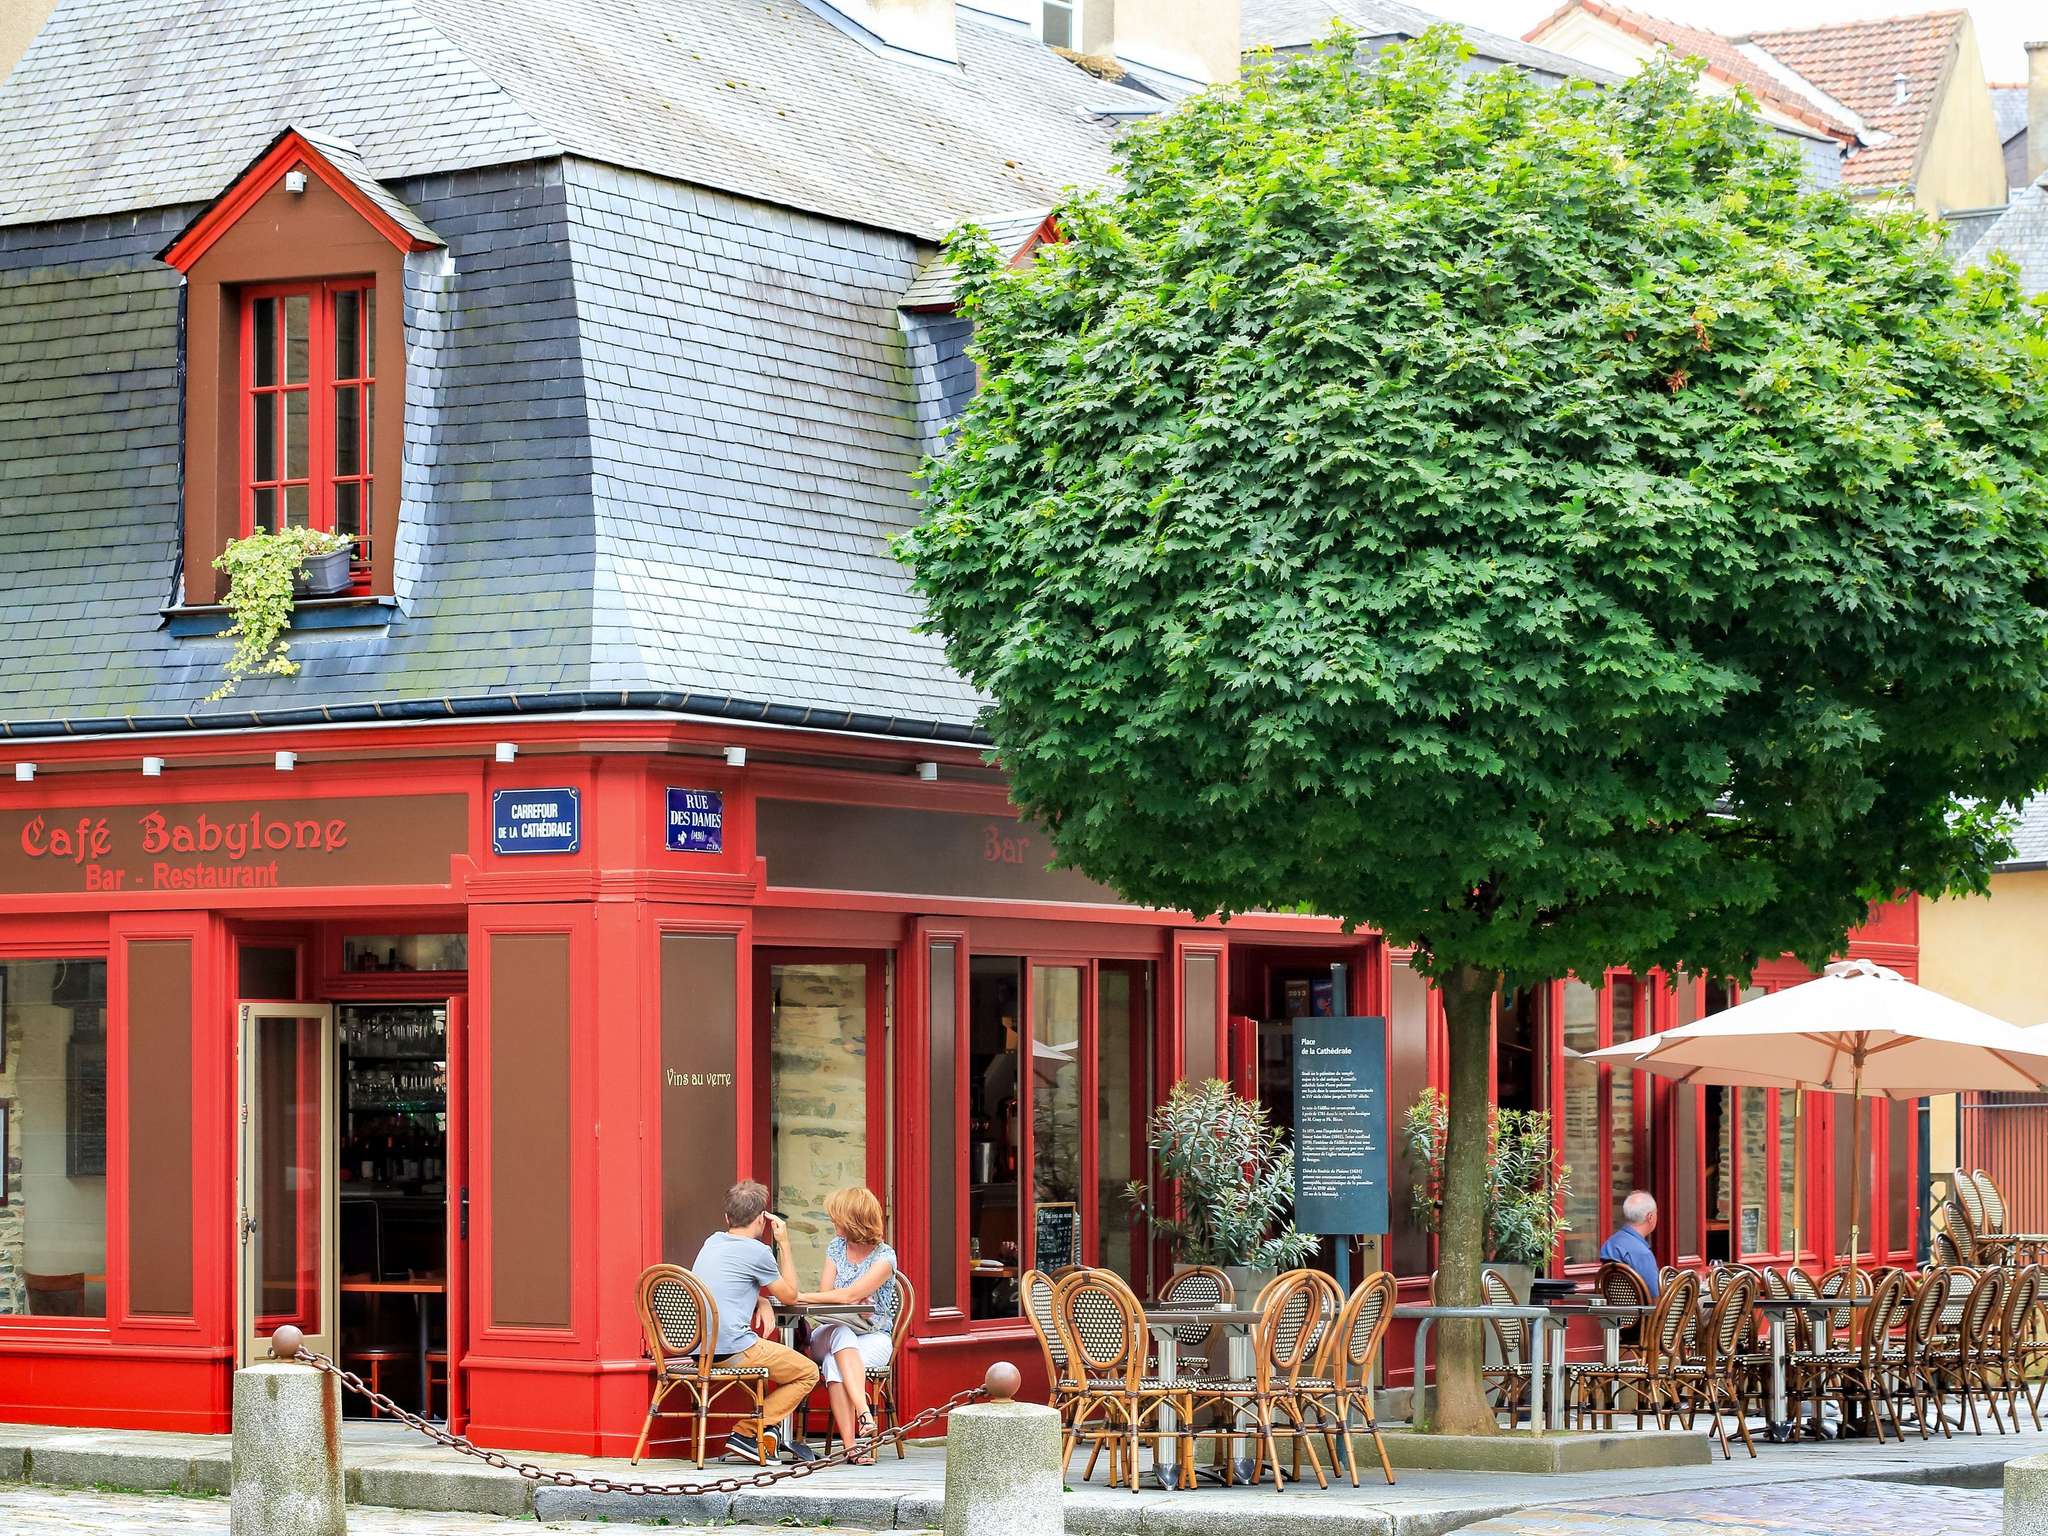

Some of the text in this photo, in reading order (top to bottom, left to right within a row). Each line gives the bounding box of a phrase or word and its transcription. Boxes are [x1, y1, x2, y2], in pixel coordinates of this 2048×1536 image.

[686, 794, 709, 809] RUE
[511, 803, 559, 819] CARREFOUR
[670, 810, 722, 828] DES DAMES
[21, 810, 347, 864] Café Babylone
[498, 819, 572, 838] DE LA CATHÉDRALE
[984, 823, 1031, 864] Bar
[85, 863, 125, 891] Bar
[153, 860, 279, 889] Restaurant
[1300, 1037, 1316, 1046] Place
[1301, 1047, 1353, 1055] de la Cathédrale
[666, 1067, 732, 1087] Vins au verre
